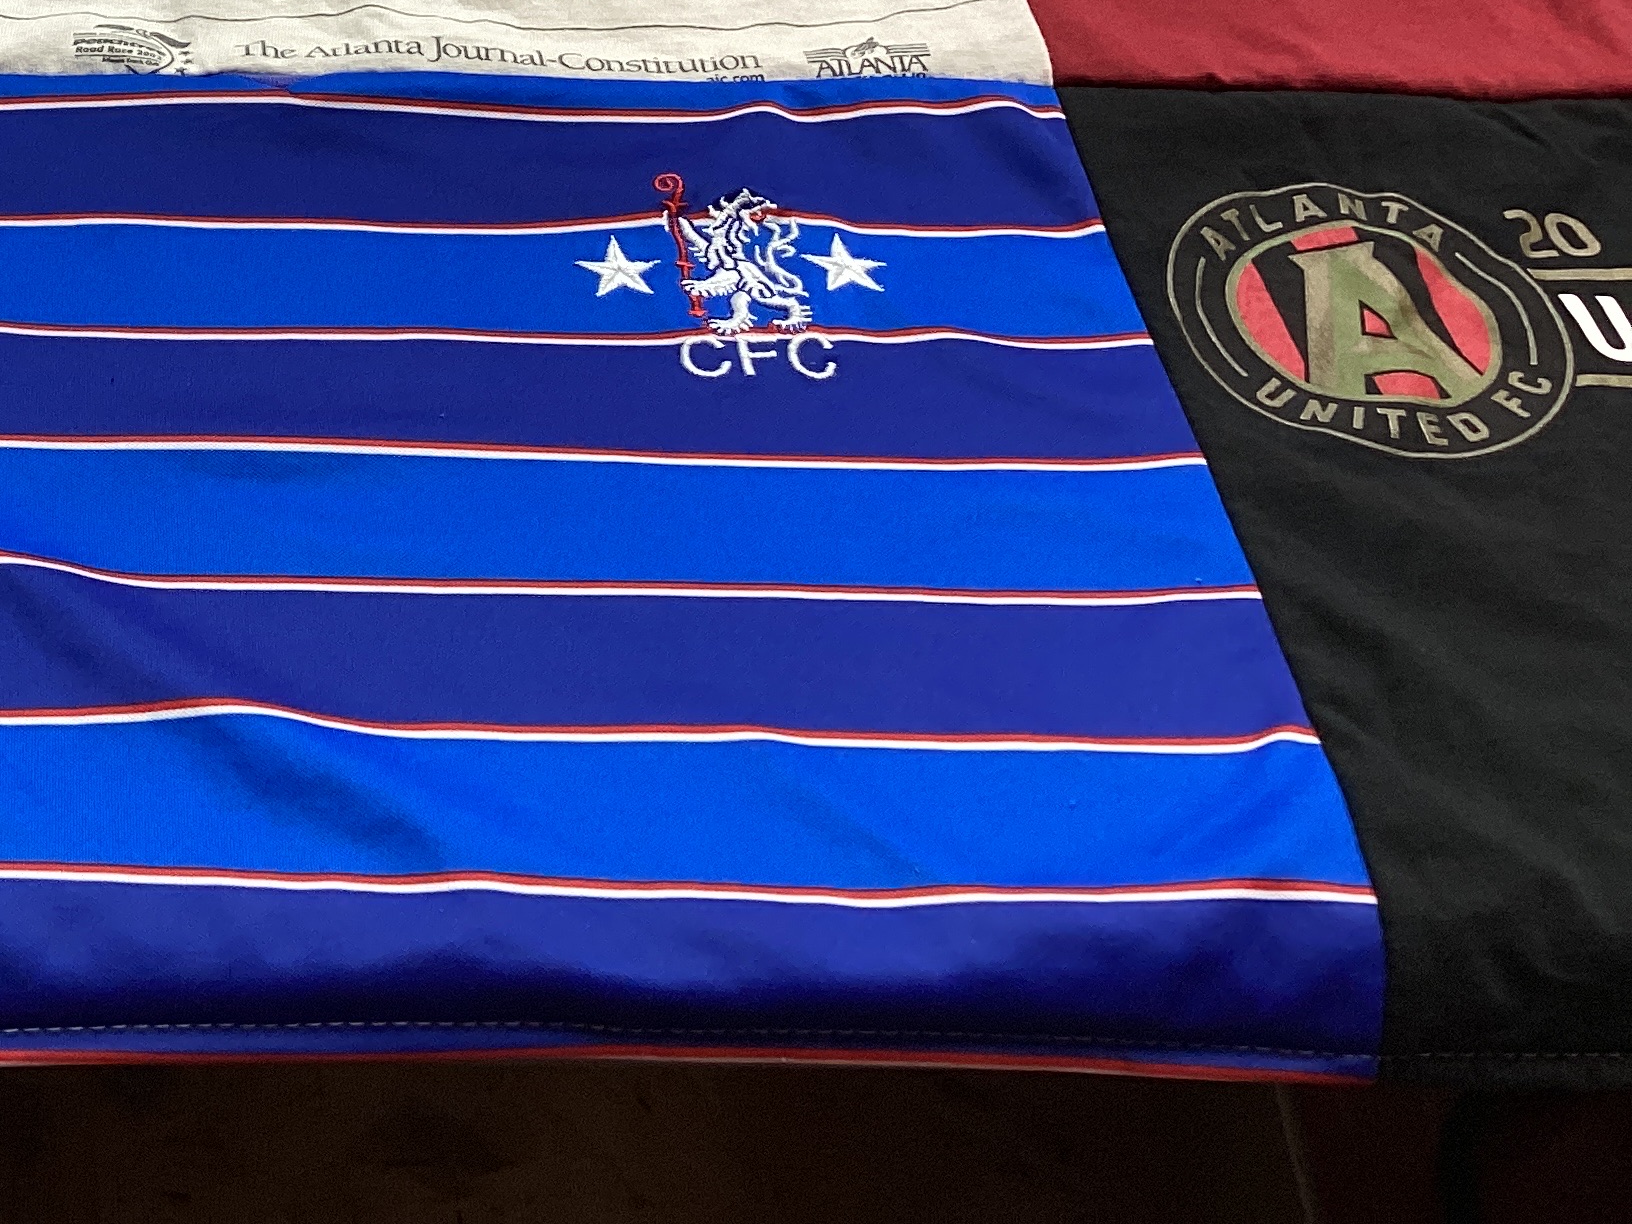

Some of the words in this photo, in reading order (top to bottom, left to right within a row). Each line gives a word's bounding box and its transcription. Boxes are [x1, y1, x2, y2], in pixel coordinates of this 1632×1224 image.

[75, 45, 105, 54] Road
[236, 39, 296, 60] The
[304, 37, 423, 60] Atlanta
[428, 35, 763, 74] Journal-Constitution
[817, 55, 930, 80] ATLANTA
[1200, 192, 1446, 261] ATLANTA
[1503, 208, 1601, 259] 20
[679, 336, 836, 379] CFC
[1255, 376, 1490, 447] UNITED
[1491, 370, 1553, 419] FC
